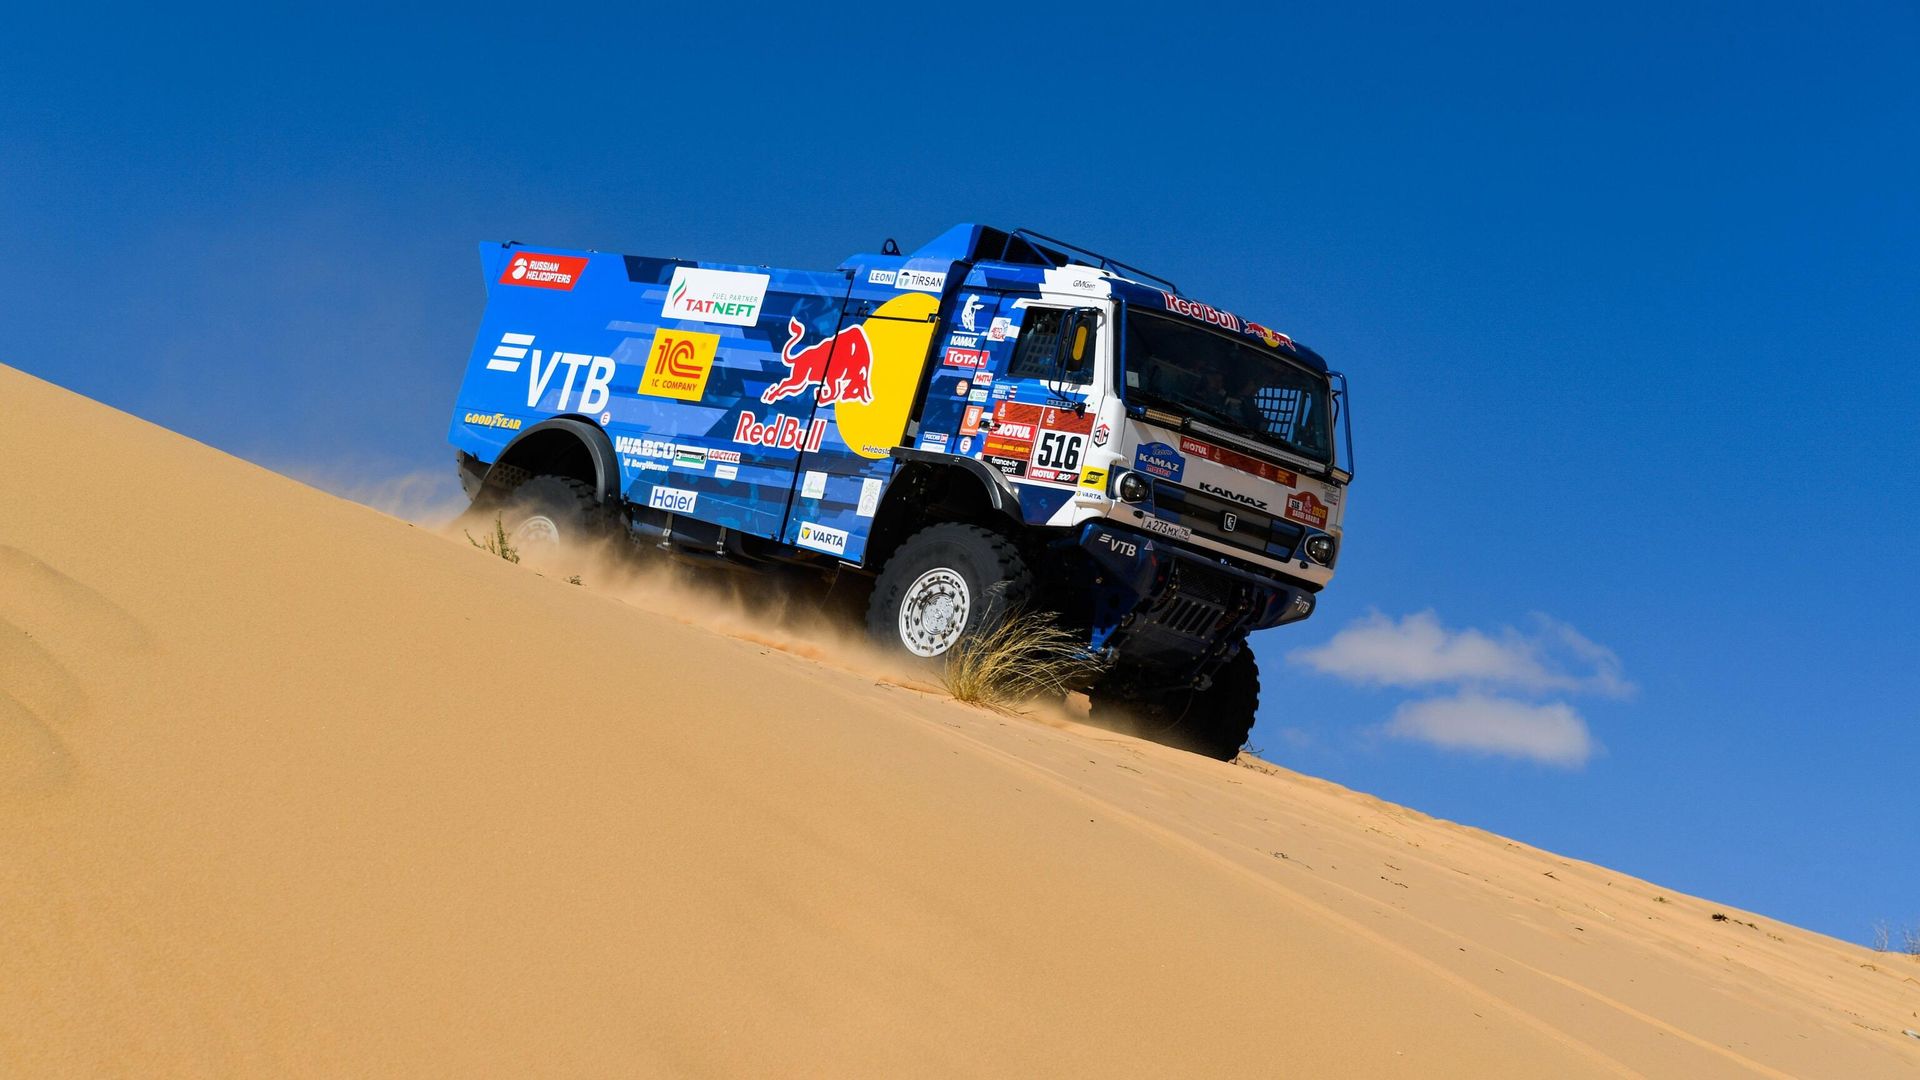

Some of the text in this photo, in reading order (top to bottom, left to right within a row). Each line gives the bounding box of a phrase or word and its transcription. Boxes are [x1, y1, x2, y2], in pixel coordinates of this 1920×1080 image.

[529, 260, 560, 272] RUSSIAN
[526, 271, 572, 284] HELICOPTERS
[871, 272, 894, 283] LEONI
[711, 292, 758, 303] FUEL PARTNER
[686, 298, 756, 317] TATNEFT
[1161, 291, 1240, 333] Red Bull
[950, 335, 978, 348] KAMAZ
[949, 350, 985, 365] TOTAL
[527, 349, 616, 414] VTB
[662, 380, 697, 392] COMPANY
[465, 412, 521, 430] GOODYEAR
[733, 411, 828, 453] Red Bull
[615, 435, 675, 460] WABCO
[710, 450, 740, 462] LOCTITE
[1038, 432, 1082, 471] 516
[1182, 441, 1207, 455] MOTUL
[1139, 453, 1180, 472] KAMAZ
[1031, 468, 1056, 479] MOTUL
[652, 488, 693, 511] Haier
[1081, 491, 1101, 500] VARTA
[1199, 482, 1268, 510] KAMAZ
[813, 529, 844, 547] VARTA
[1110, 539, 1137, 557] VTB
